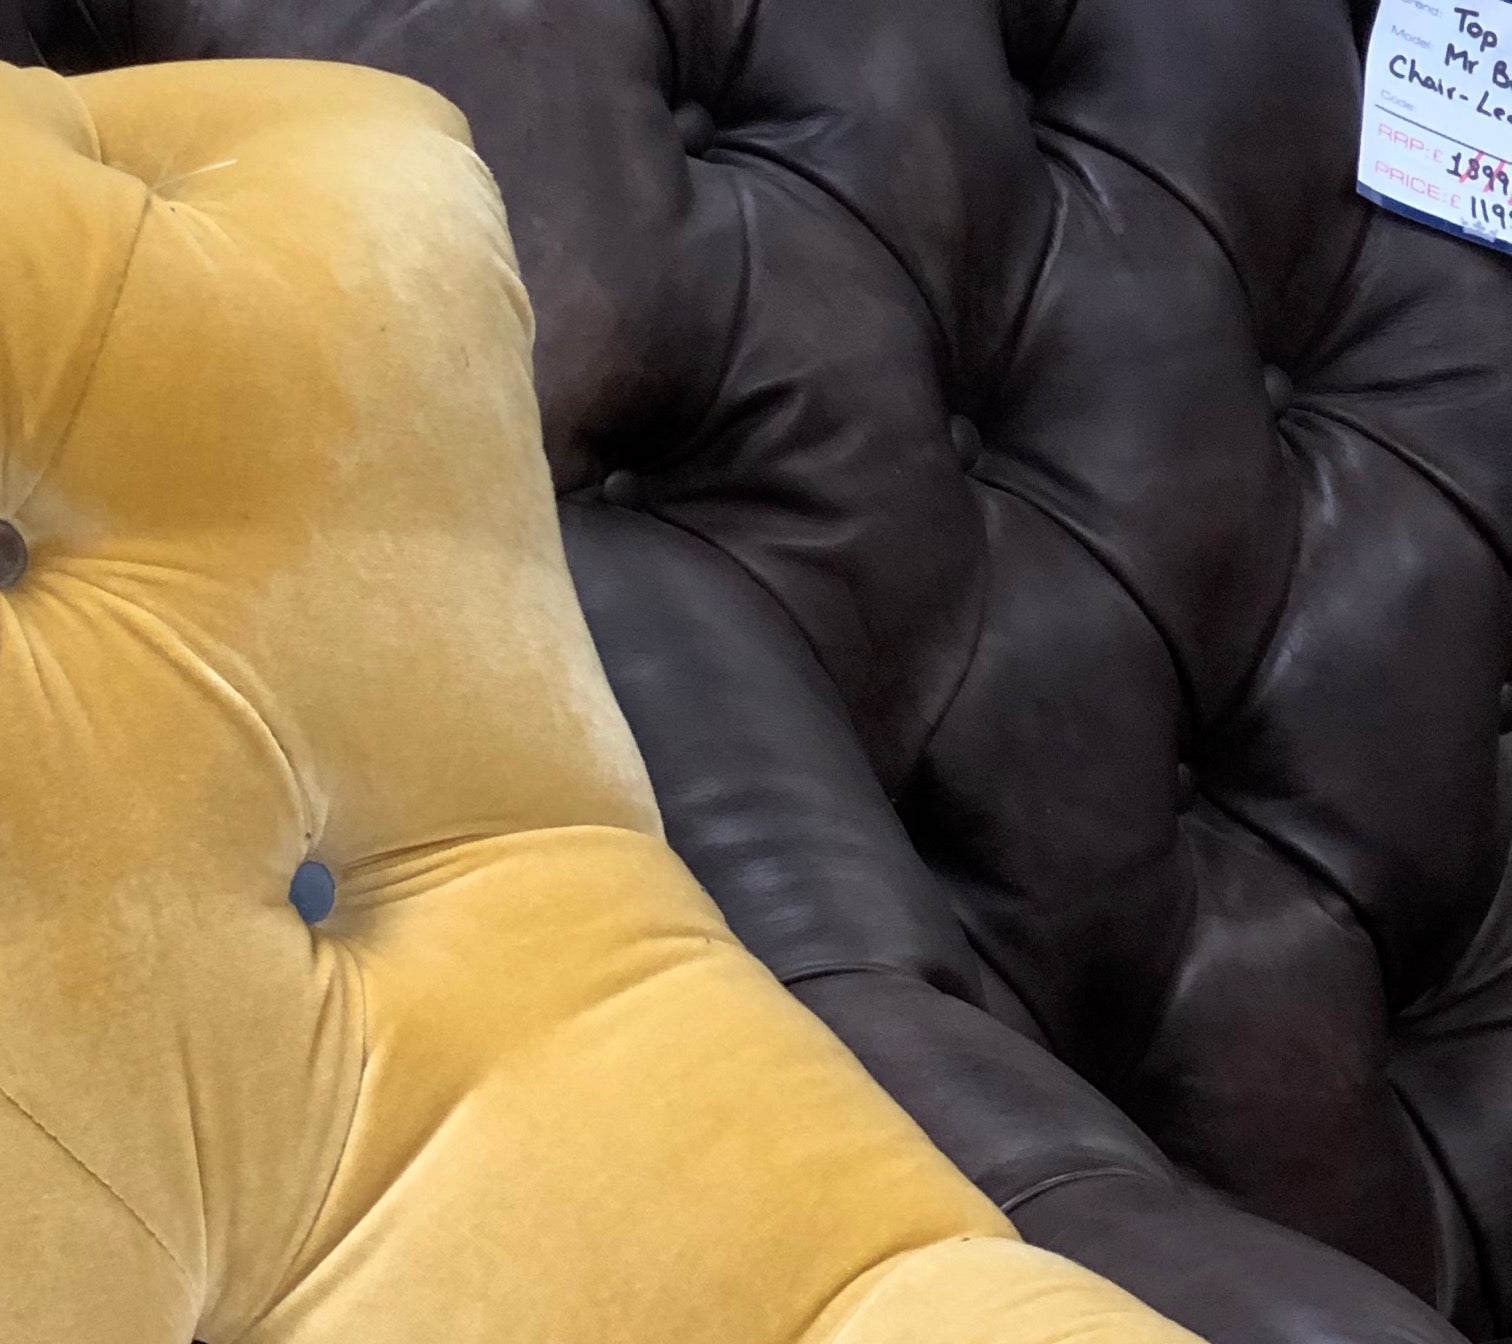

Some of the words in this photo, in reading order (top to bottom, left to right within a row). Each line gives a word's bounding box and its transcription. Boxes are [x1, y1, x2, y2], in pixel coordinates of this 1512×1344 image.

[1454, 7, 1498, 52] Top
[1445, 43, 1479, 74] Mr
[1492, 60, 1512, 91] B
